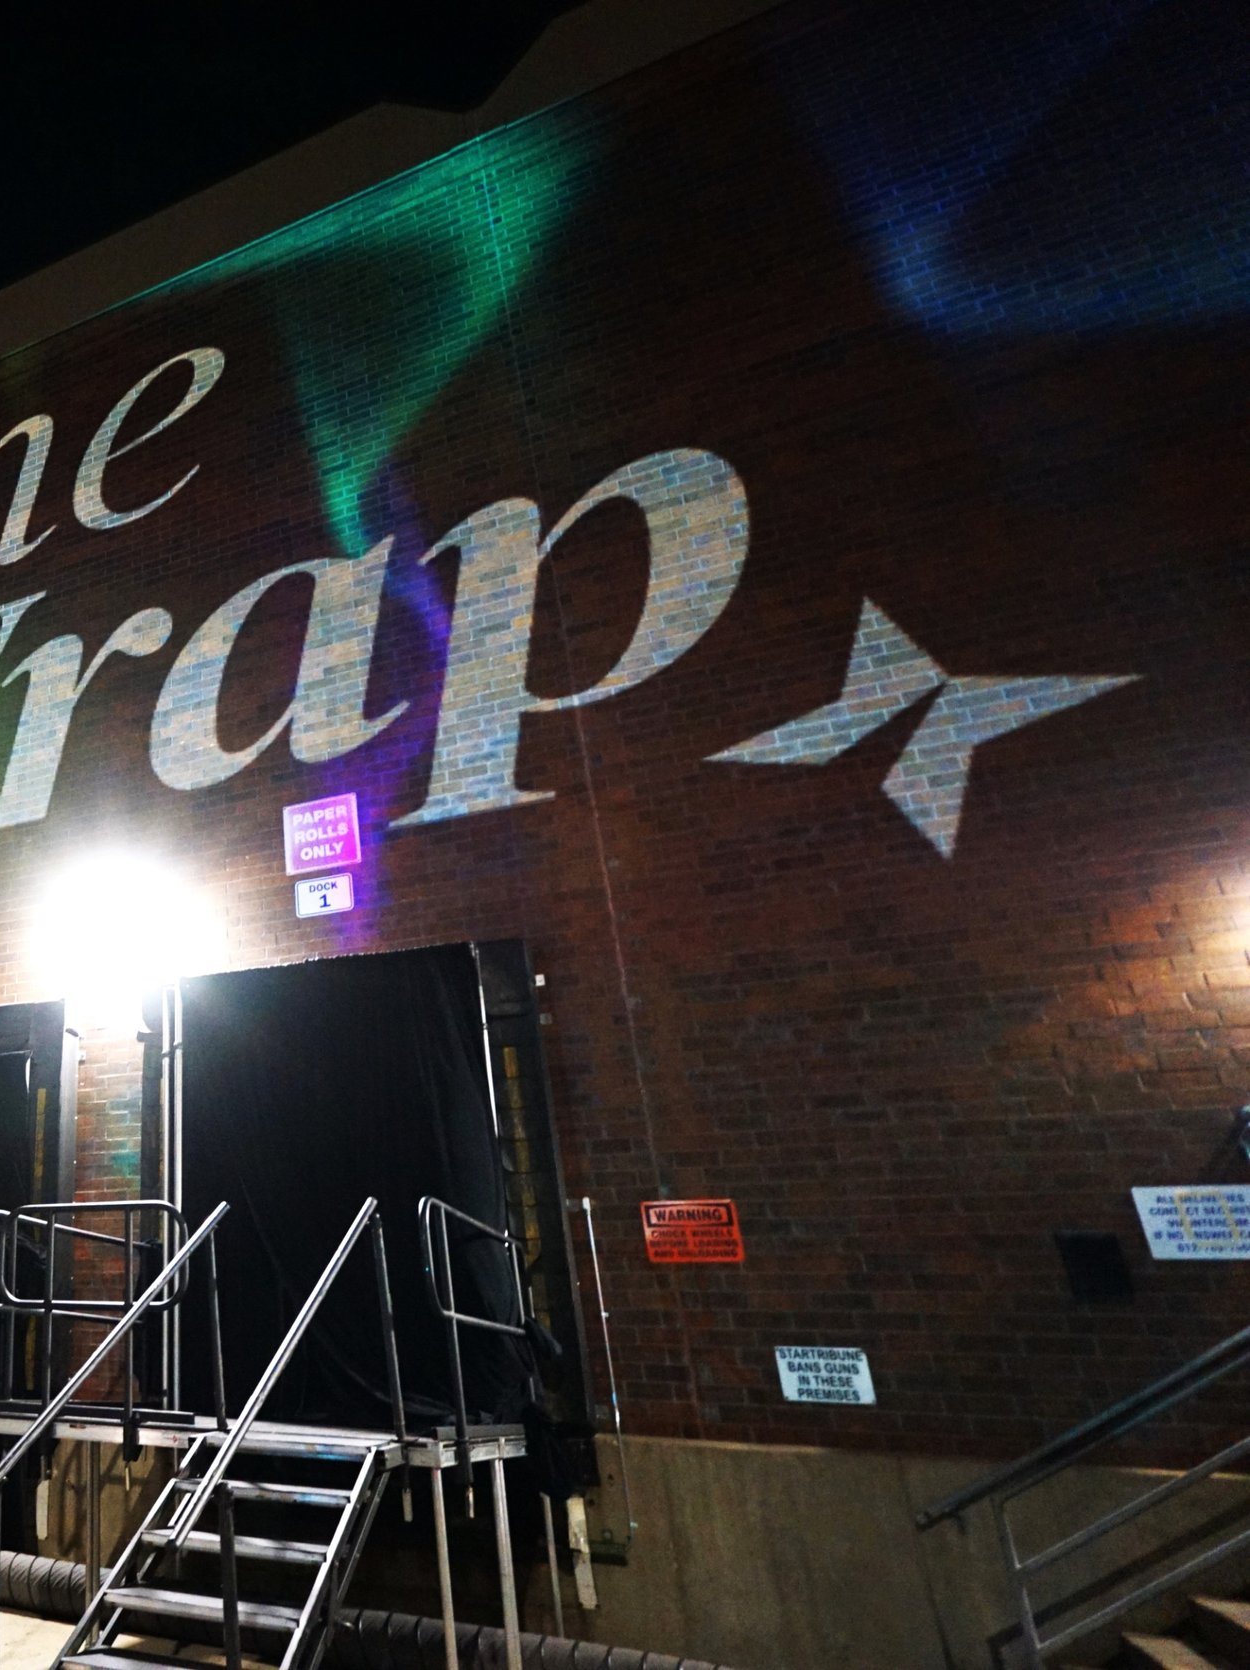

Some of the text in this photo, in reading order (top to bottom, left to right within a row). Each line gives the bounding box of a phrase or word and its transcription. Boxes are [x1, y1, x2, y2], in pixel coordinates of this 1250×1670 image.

[292, 805, 348, 826] PAPER
[294, 822, 349, 844] ROLLS
[300, 841, 344, 861] ONLY
[309, 881, 338, 893] DOCK
[319, 894, 331, 908] 1
[654, 1208, 723, 1222] WARNING
[1149, 1206, 1199, 1216] CONTCT
[779, 1348, 863, 1362] STARTRIBUNE
[788, 1361, 859, 1375] BANS GUNS
[797, 1375, 854, 1388] IN THESE
[797, 1387, 860, 1402] PREMISES
